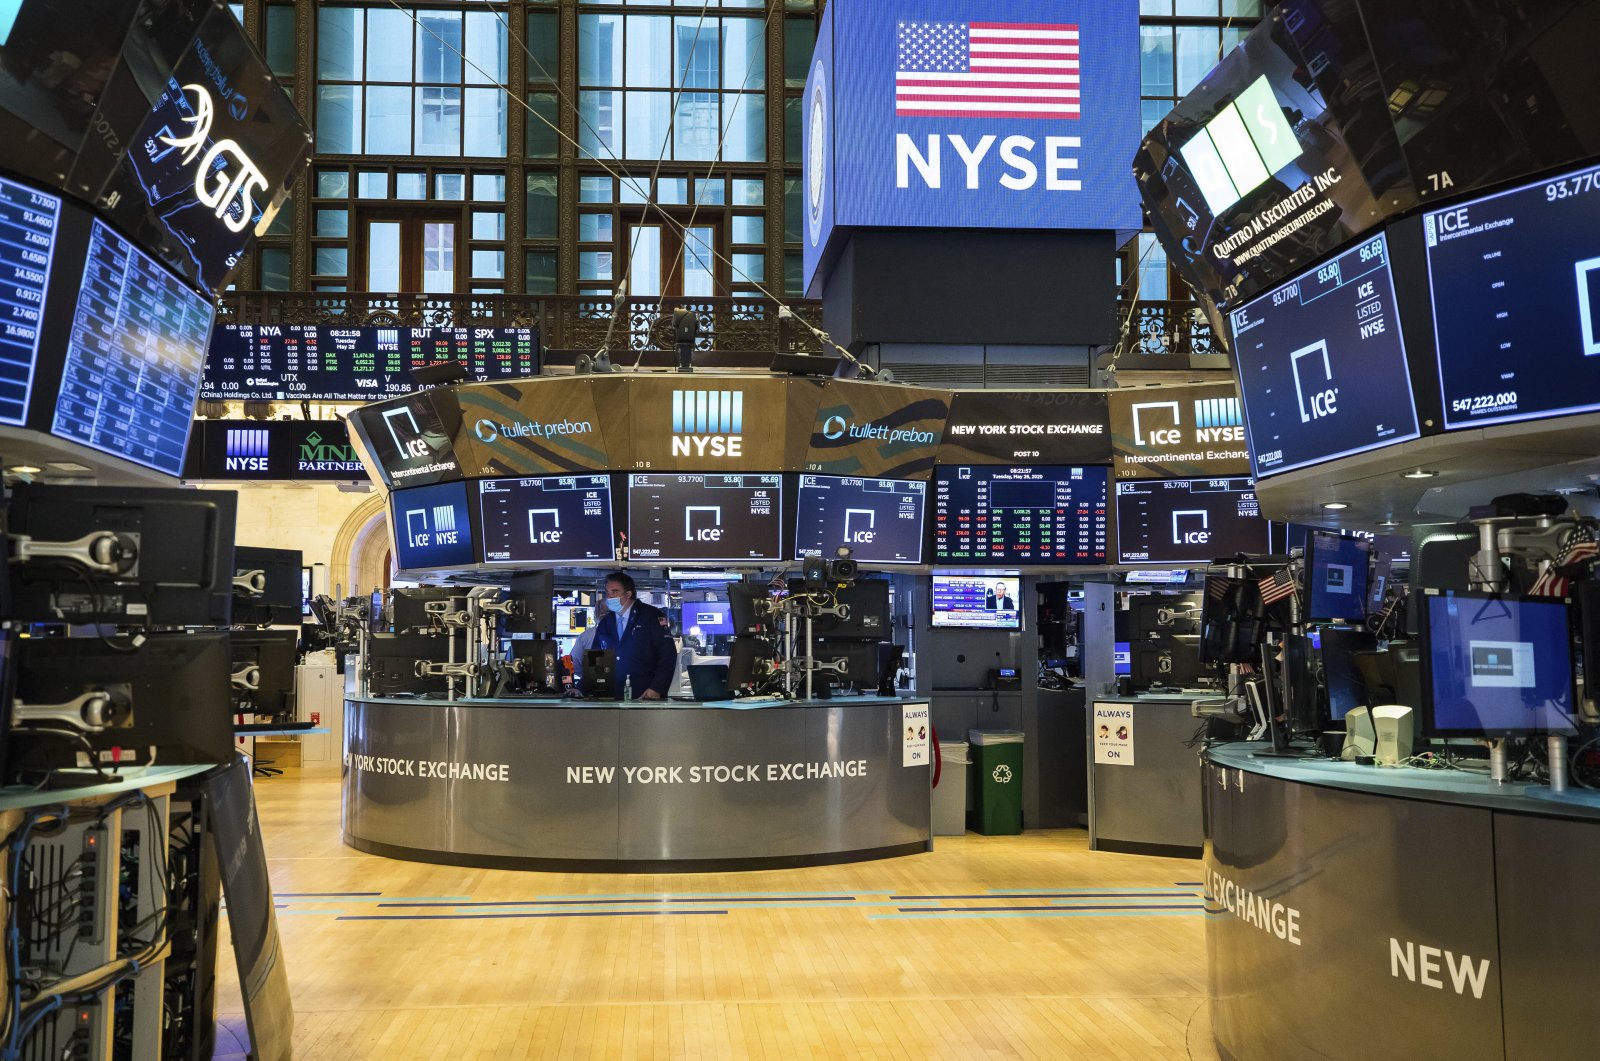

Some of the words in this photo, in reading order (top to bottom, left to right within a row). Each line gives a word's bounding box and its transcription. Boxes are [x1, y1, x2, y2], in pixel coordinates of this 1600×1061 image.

[896, 134, 1082, 191] NYSE
[196, 139, 268, 232] GTS
[1427, 171, 1454, 191] 7A
[1213, 226, 1252, 258] QUATTRO
[1250, 216, 1264, 234] M
[1261, 182, 1316, 227] SECURITIES
[1438, 208, 1470, 233] ICE
[1440, 224, 1484, 241] Intercontinental
[1485, 218, 1514, 230] Exchange
[25, 232, 50, 247] 2.6200
[1360, 240, 1382, 262] 96.69
[14, 268, 43, 283] 14.5500
[1318, 262, 1338, 283] 93.80
[16, 288, 41, 302] 0.9172
[1225, 284, 1238, 299] 7B
[1273, 284, 1298, 306] 93.7700
[1358, 281, 1374, 299] ICE
[13, 307, 38, 320] 2.7400
[1236, 310, 1249, 328] ICE
[1356, 301, 1381, 320] LISTED
[260, 326, 281, 336] NYA
[412, 328, 432, 338] RUT
[475, 329, 494, 338] SPX
[1360, 319, 1386, 339] NYSE
[222, 382, 239, 390] 0.00
[289, 383, 306, 391] 0.00
[355, 379, 378, 387] VISA
[384, 384, 411, 392] 190.86
[1452, 392, 1517, 411] 547,222,000
[501, 422, 542, 438] tullett
[545, 419, 592, 439] prebon
[849, 422, 888, 440] tullett
[889, 427, 934, 444] prebon
[951, 425, 976, 435] NEW
[979, 425, 1007, 434] YORK
[1010, 425, 1044, 434] STOCK
[1047, 424, 1103, 434] EXCHANGE
[1196, 426, 1245, 443] NYSE
[672, 436, 742, 456] NYSE
[226, 458, 268, 470] NYSE
[1125, 452, 1204, 464] Intercontinental
[429, 462, 456, 472] Exchange
[804, 477, 816, 485] ICE
[436, 532, 458, 545] NYSE
[905, 711, 928, 719] ALWAYS
[1097, 710, 1131, 718] ALWAYS
[354, 754, 374, 772] YORK
[376, 757, 414, 776] STOCK
[419, 761, 509, 781] EXCHANGE
[566, 766, 615, 784] NEW
[623, 766, 683, 784] YORK
[689, 764, 760, 782] STOCK
[767, 760, 867, 781] EXCHANGE
[1213, 871, 1301, 946] EXCHANGE
[1389, 937, 1490, 999] NEW
